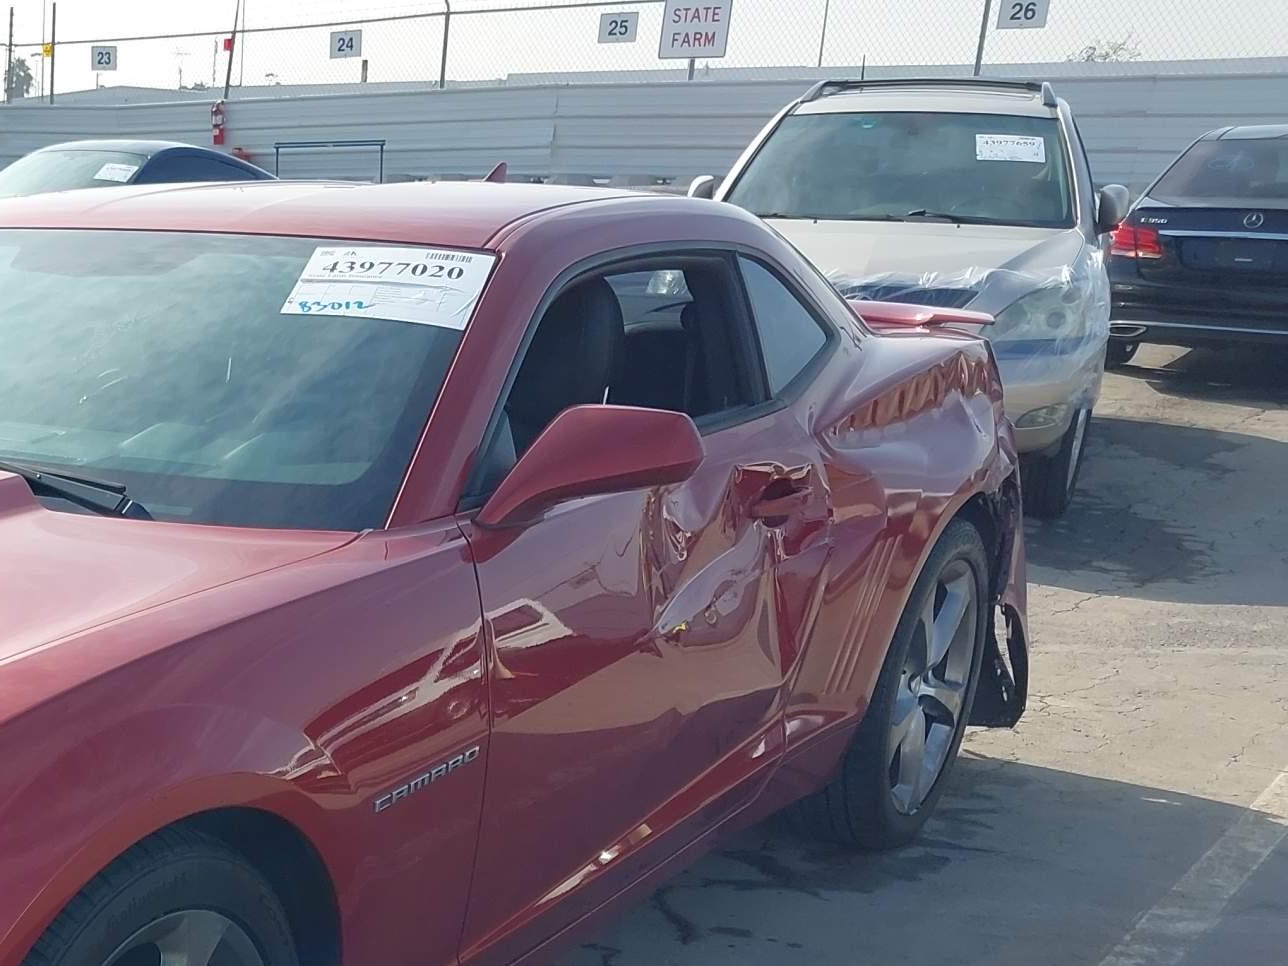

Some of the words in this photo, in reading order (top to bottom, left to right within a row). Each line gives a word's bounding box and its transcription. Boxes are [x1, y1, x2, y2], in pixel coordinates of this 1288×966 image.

[671, 6, 722, 24] STATE
[1009, 2, 1038, 21] 26
[607, 19, 629, 36] 25
[337, 36, 354, 52] 24
[671, 31, 716, 48] FARM
[97, 51, 111, 65] 23
[322, 260, 464, 280] 43977020
[375, 745, 480, 813] CAMARO
